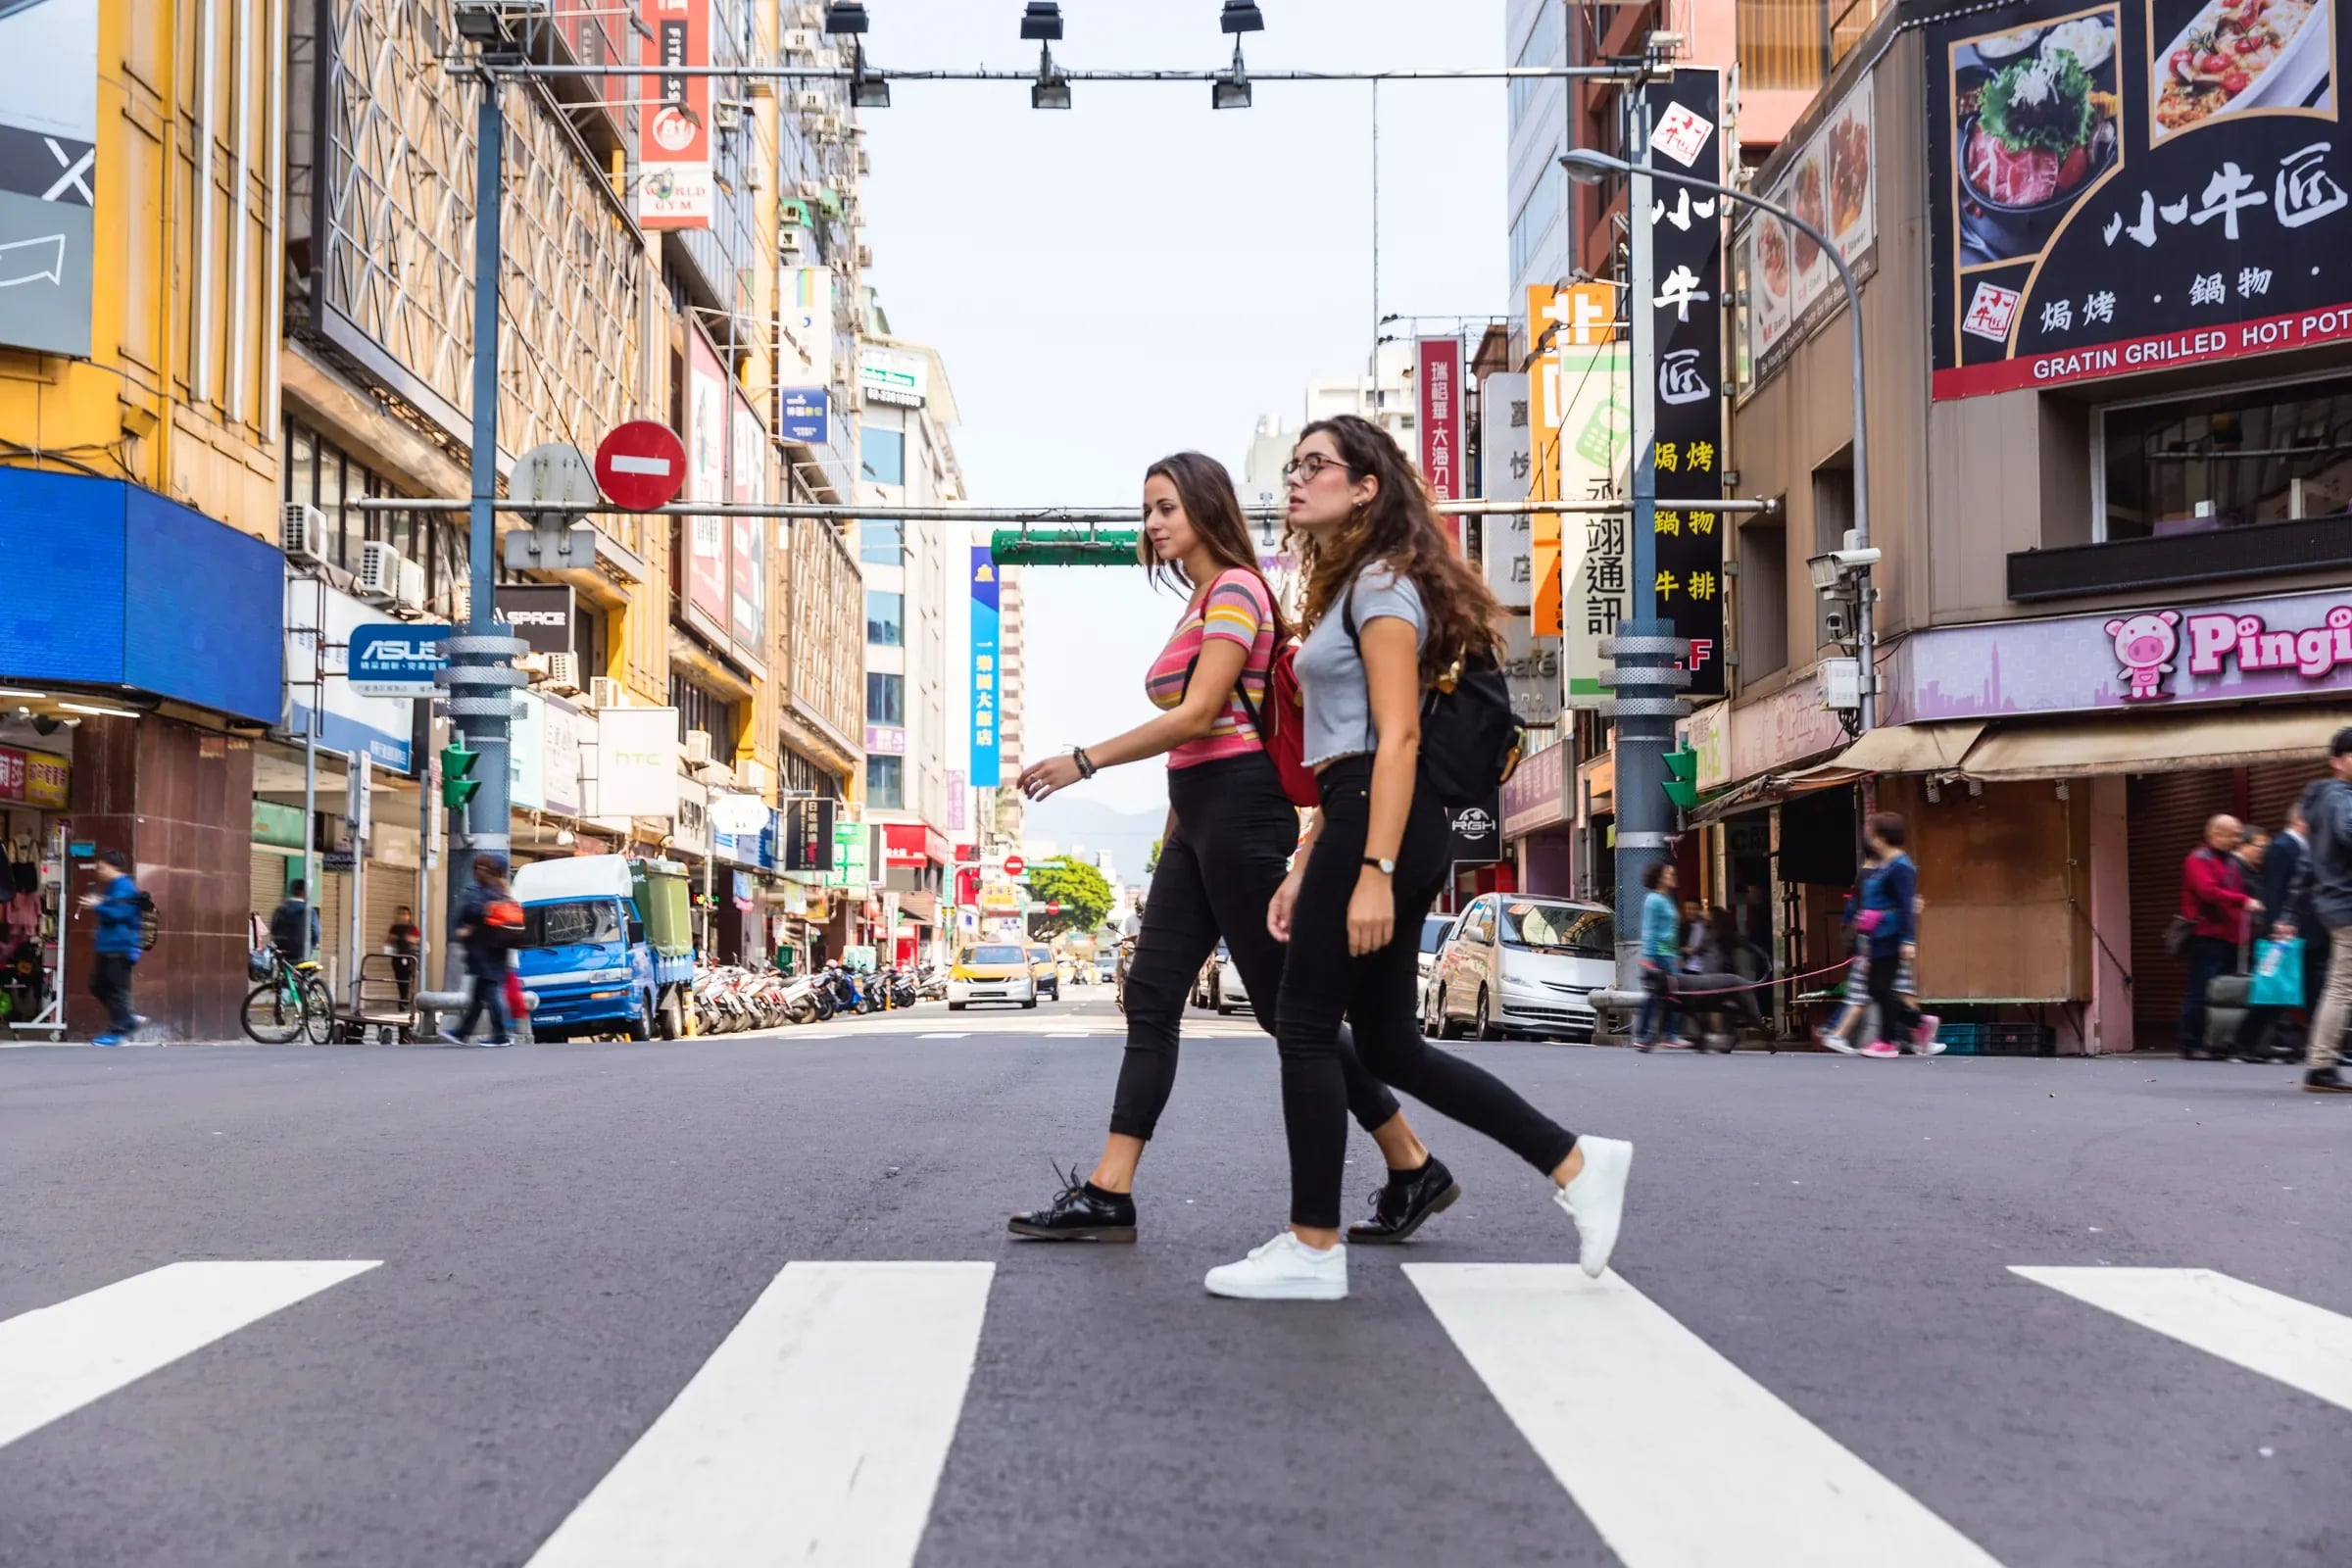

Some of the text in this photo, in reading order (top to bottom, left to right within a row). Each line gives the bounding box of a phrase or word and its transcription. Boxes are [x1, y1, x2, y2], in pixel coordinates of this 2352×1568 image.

[645, 187, 706, 197] WRLD
[2102, 142, 2348, 248] 小牛匠
[2041, 267, 2273, 334] 焗烤 鍋物
[2034, 309, 2352, 379] GRATIN GRILLED HOT POT
[1654, 441, 1714, 472] 焗烤
[1654, 509, 1715, 537] 鍋物
[1654, 569, 1716, 602] 牛排
[507, 612, 566, 625] SPACE
